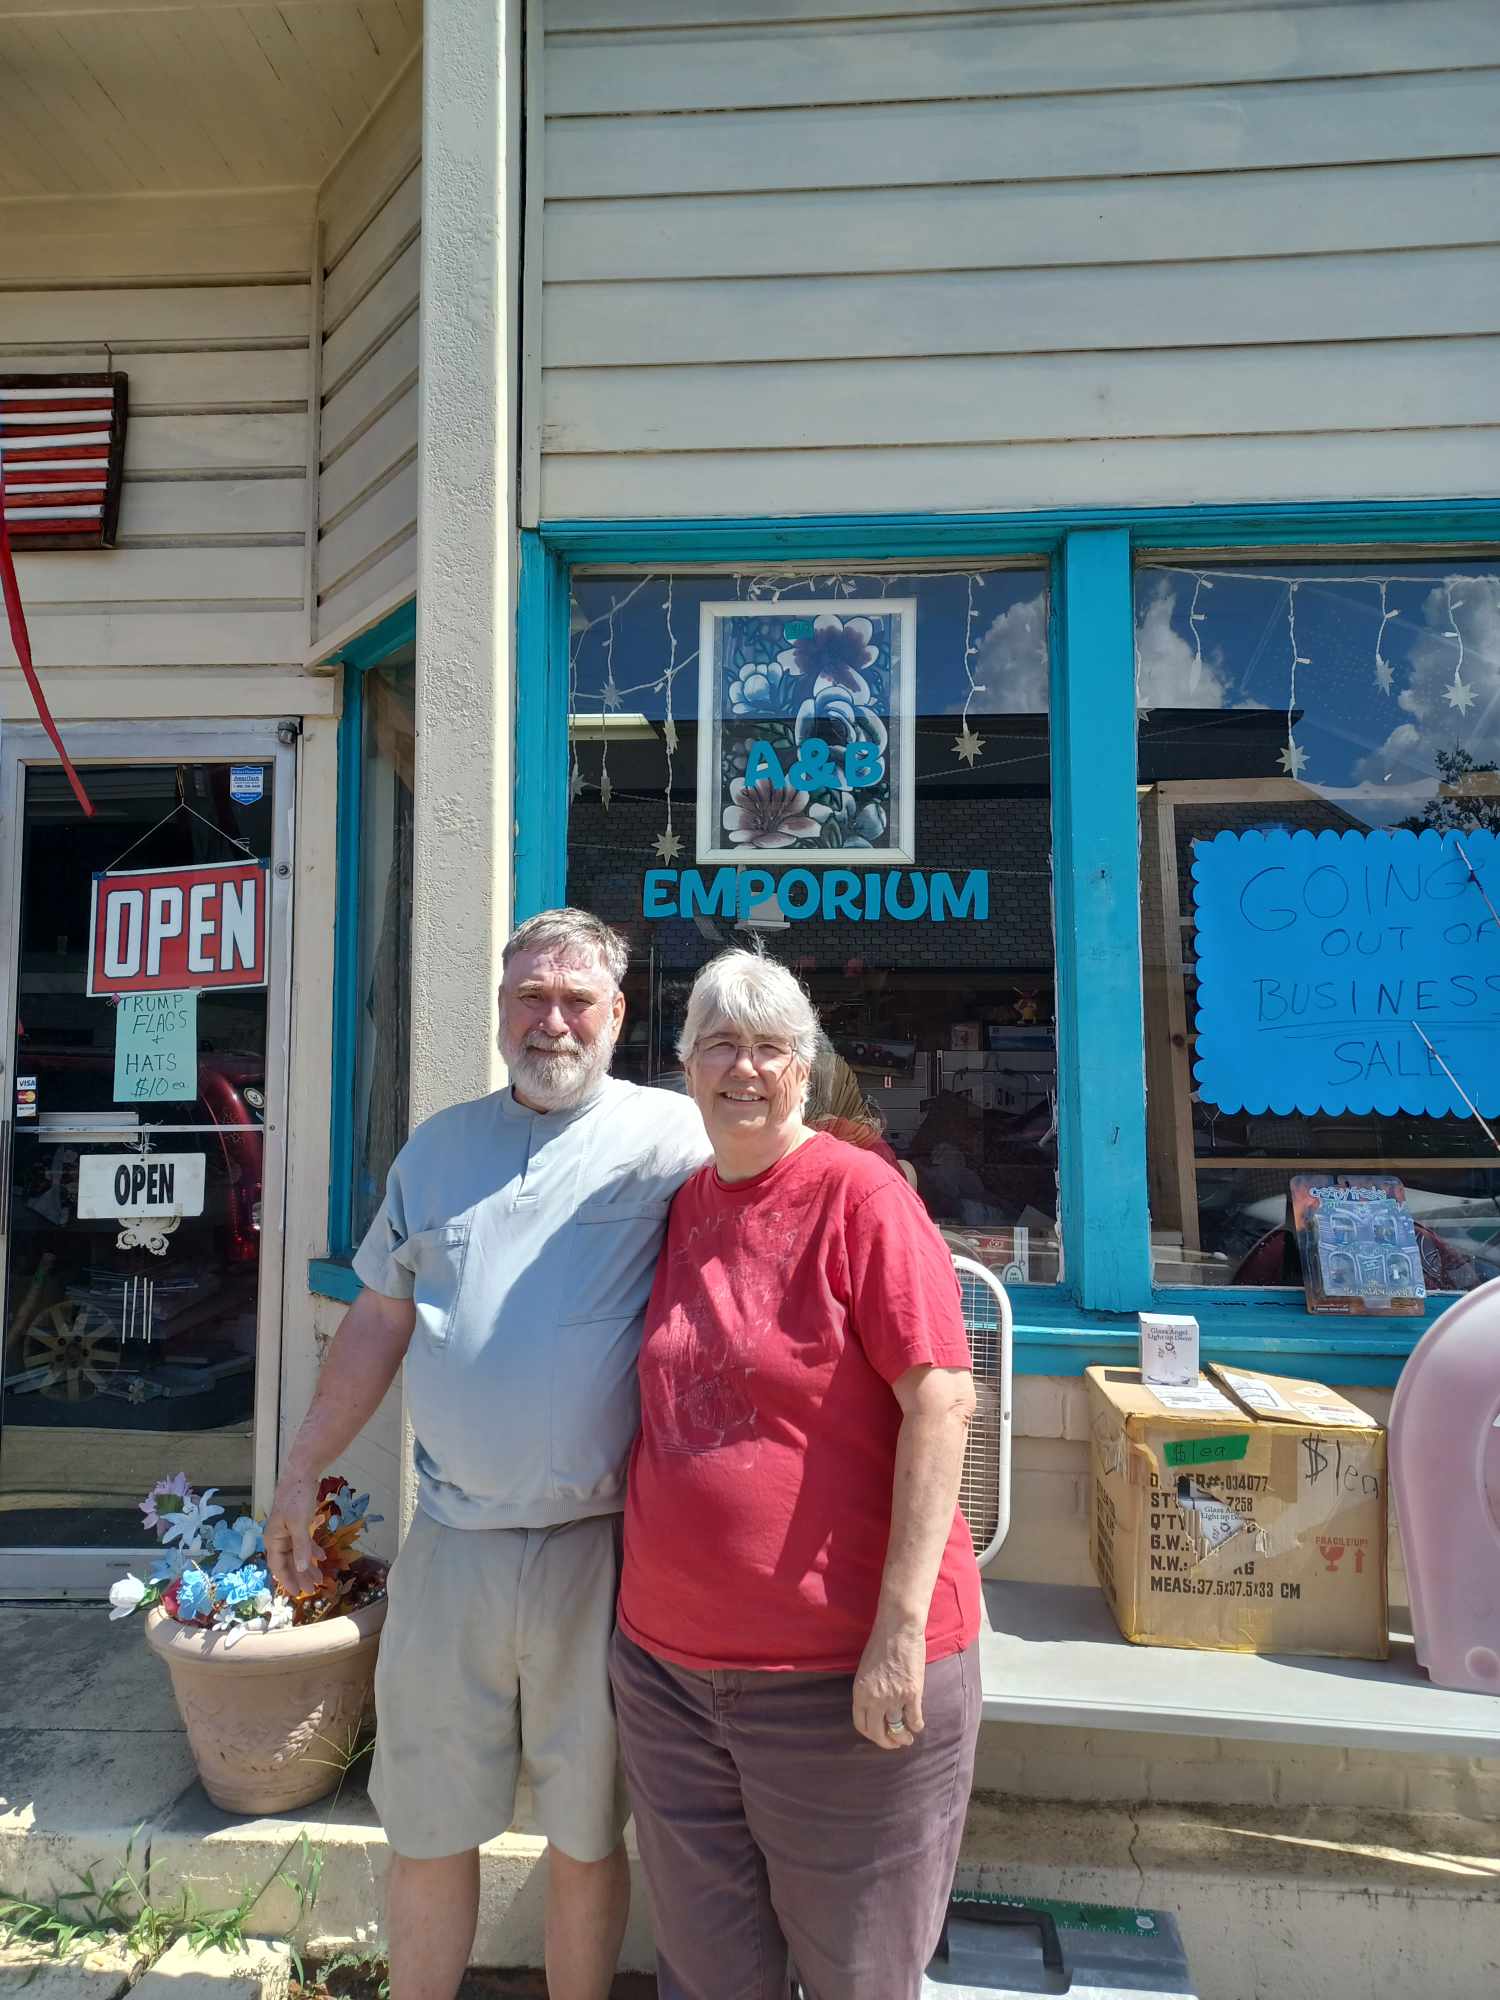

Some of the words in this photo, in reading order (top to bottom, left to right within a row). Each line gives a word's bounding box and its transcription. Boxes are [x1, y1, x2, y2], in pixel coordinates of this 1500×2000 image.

[744, 738, 885, 791] A&B
[642, 867, 989, 922] EMPORIUM
[1240, 857, 1485, 931] GOING
[103, 878, 257, 979] OPEN
[1321, 927, 1414, 957] OUT
[1443, 917, 1500, 945] OF
[119, 993, 184, 1013] TRUMP
[132, 1010, 189, 1035] FLAGS
[125, 1052, 177, 1076] HATS
[1328, 1040, 1461, 1087] SALE
[19, 1079, 36, 1087] VISA
[131, 1077, 169, 1098] $10
[114, 1163, 175, 1206] OPEN
[1151, 1554, 1187, 1572] N.W.:
[1280, 1582, 1301, 1600] CM
